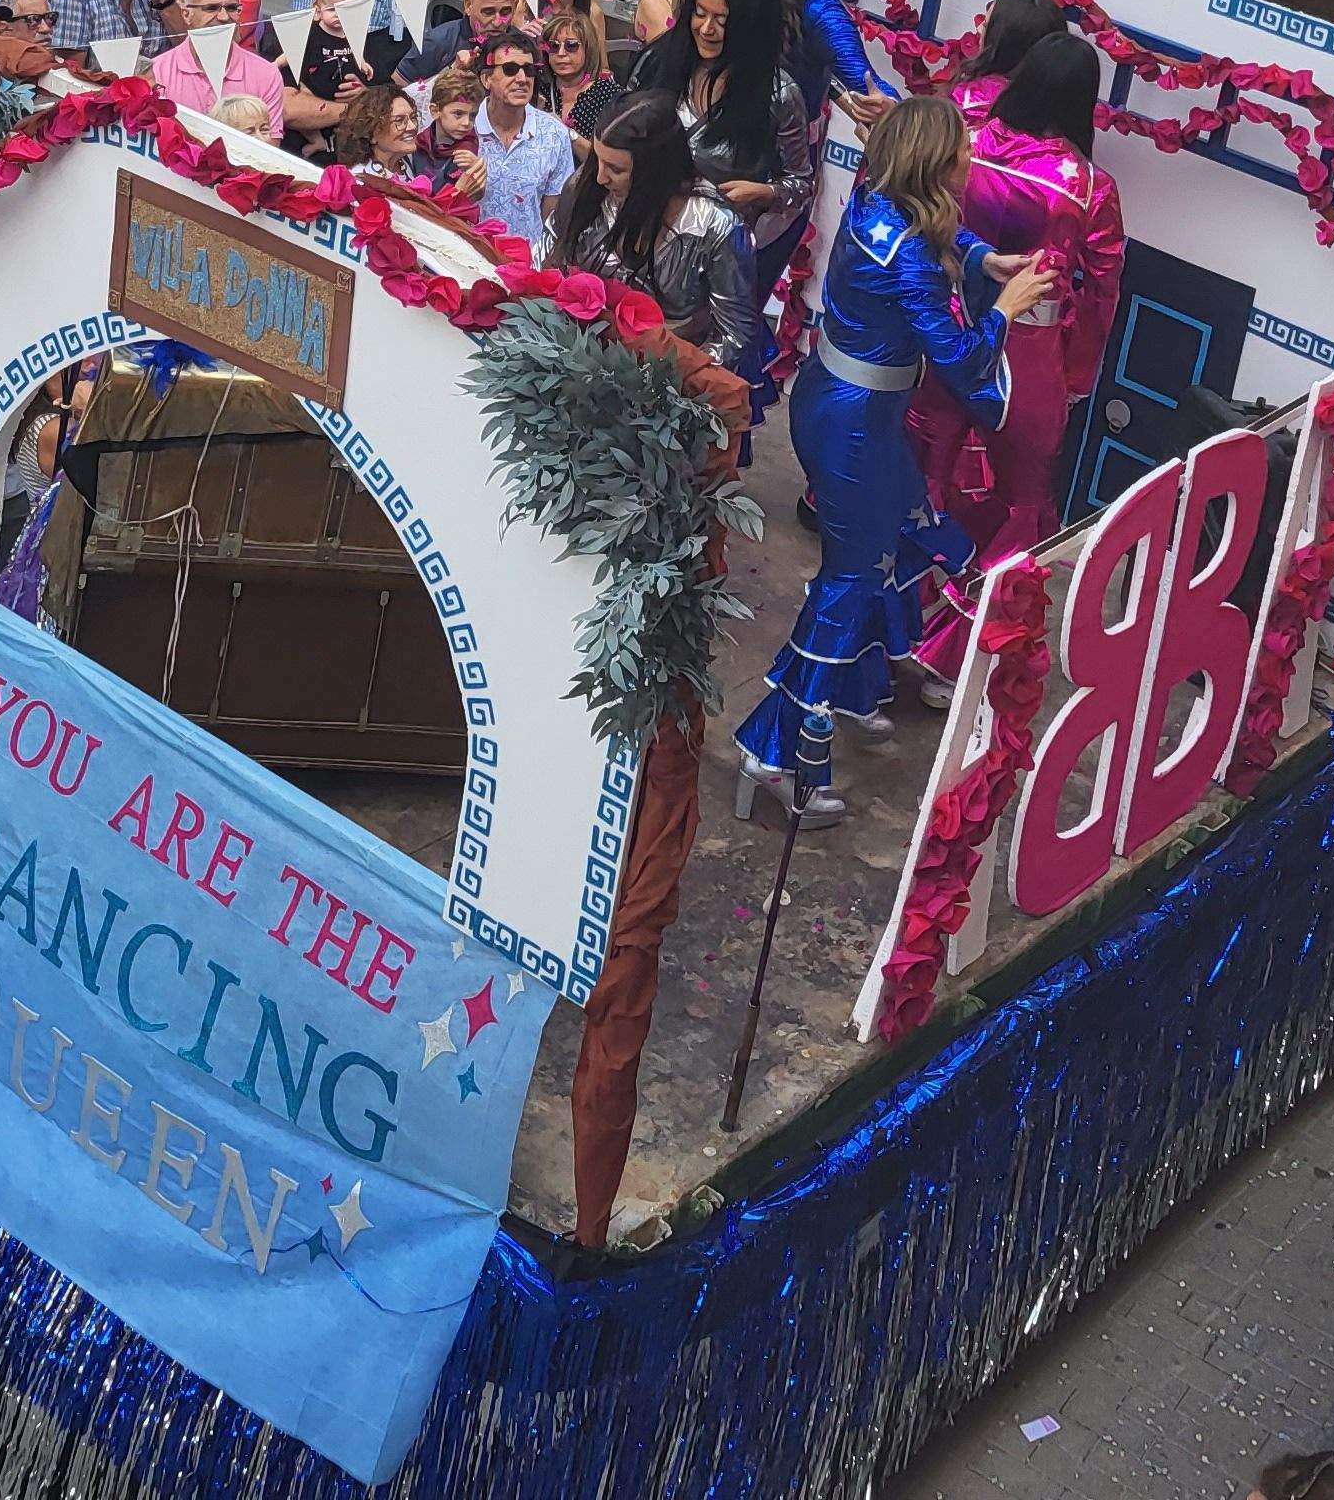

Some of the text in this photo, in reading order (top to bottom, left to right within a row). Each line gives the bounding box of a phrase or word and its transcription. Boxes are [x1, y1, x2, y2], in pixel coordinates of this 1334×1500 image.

[130, 219, 325, 374] VILLA DONNA
[108, 774, 256, 908] ARE
[268, 863, 416, 1016] THE
